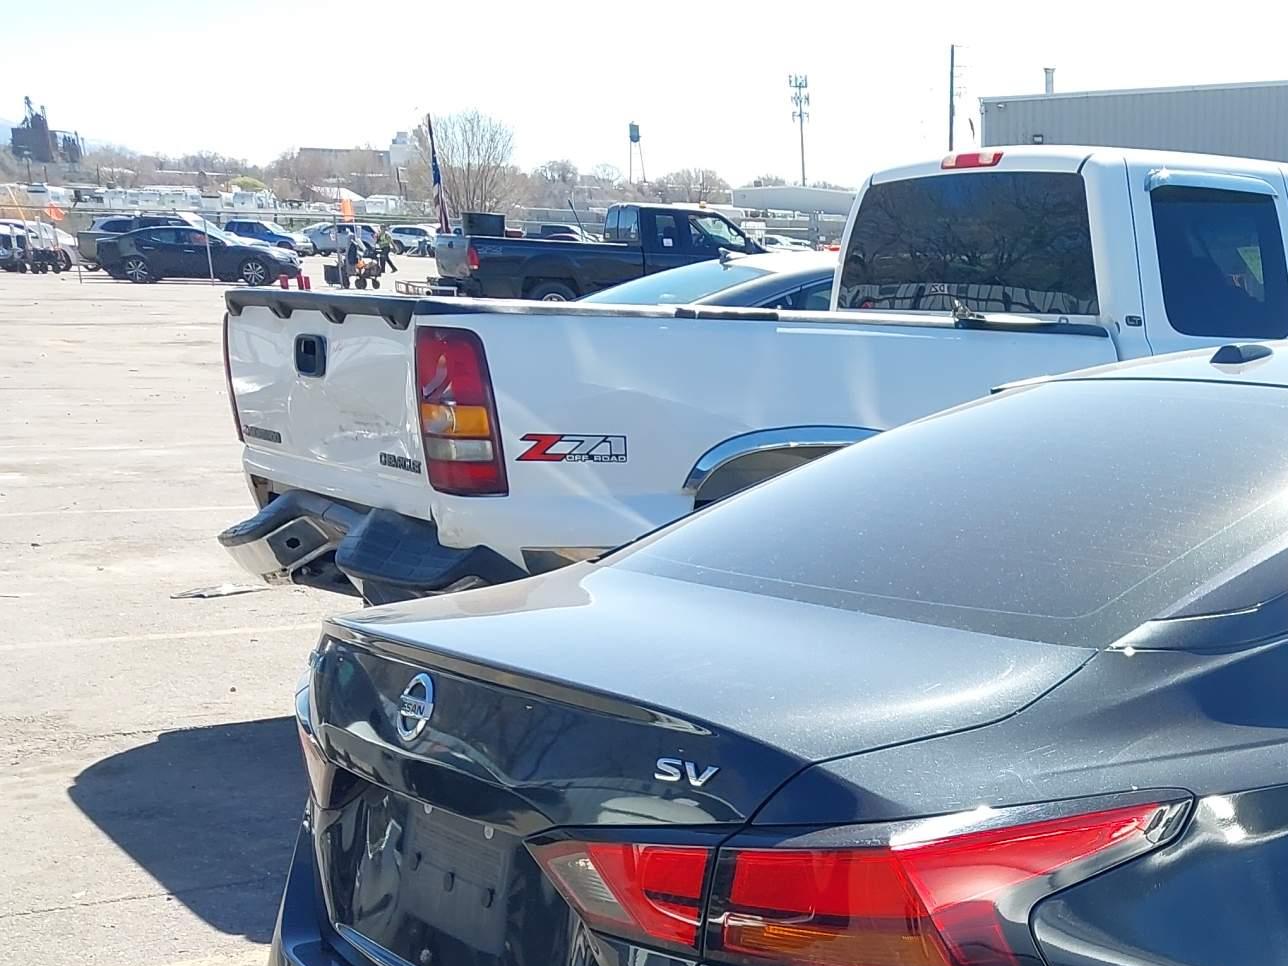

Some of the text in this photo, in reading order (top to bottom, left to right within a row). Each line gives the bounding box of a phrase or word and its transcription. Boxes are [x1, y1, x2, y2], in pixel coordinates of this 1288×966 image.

[1126, 316, 1141, 326] LT
[515, 433, 627, 462] Z71
[565, 454, 590, 462] OFF
[654, 757, 720, 786] SV
